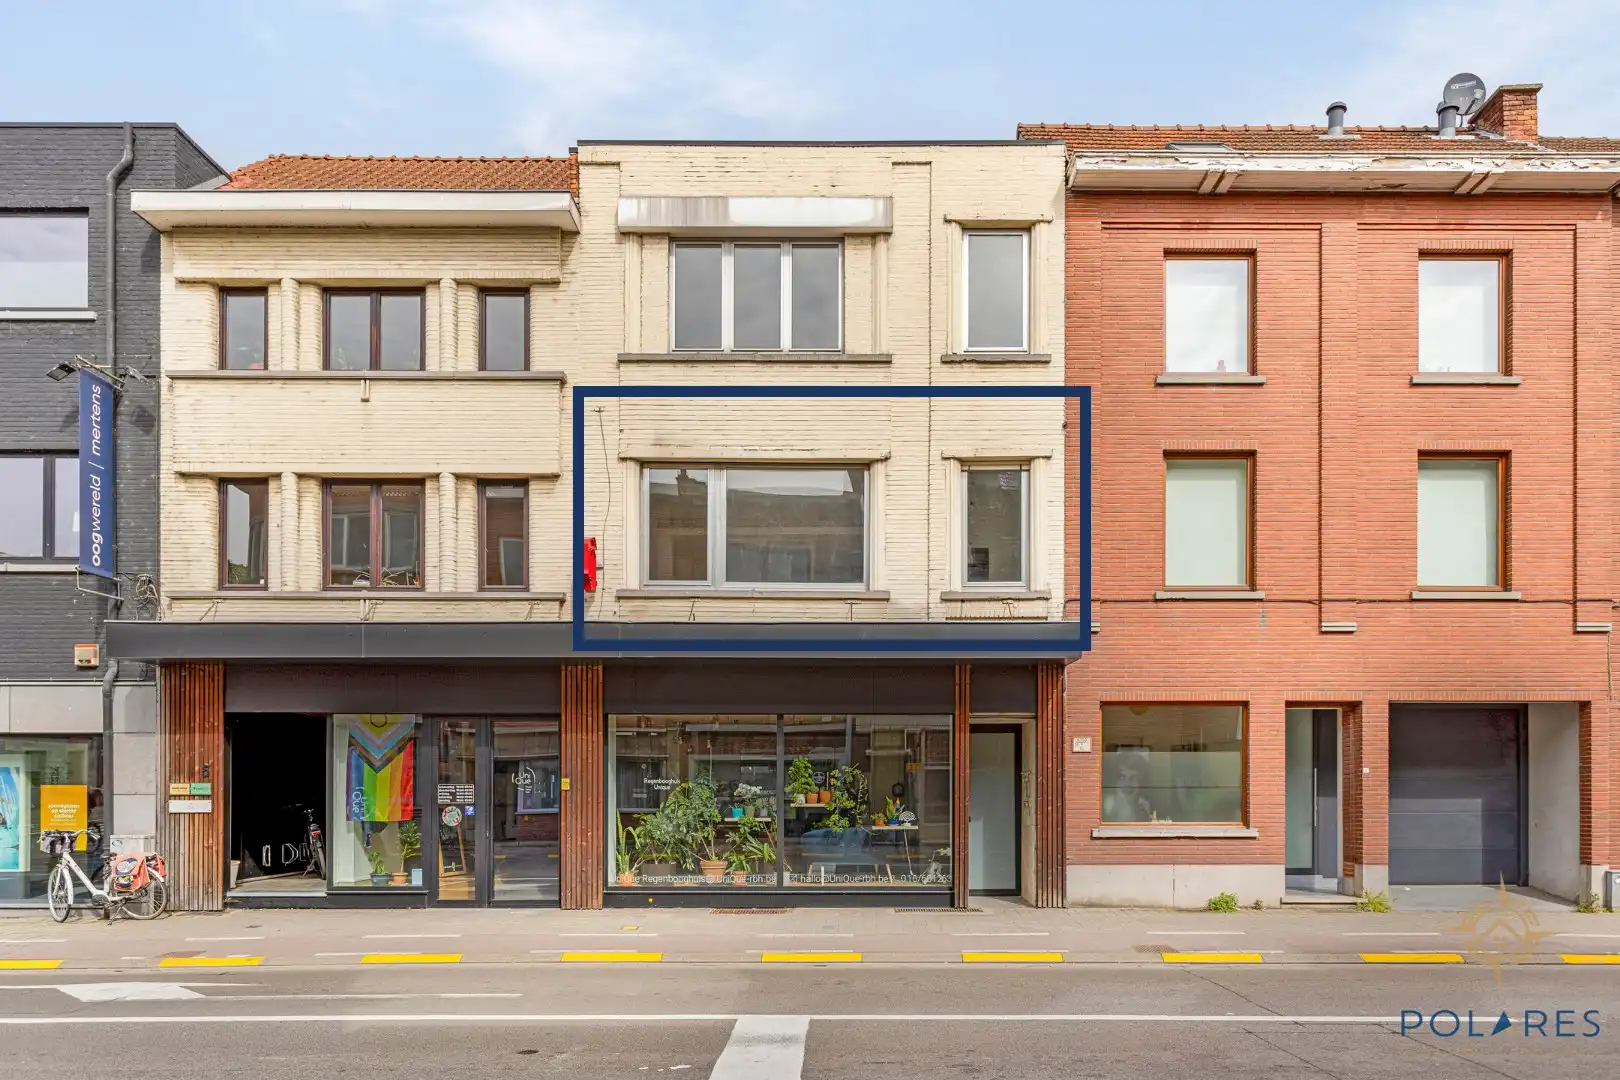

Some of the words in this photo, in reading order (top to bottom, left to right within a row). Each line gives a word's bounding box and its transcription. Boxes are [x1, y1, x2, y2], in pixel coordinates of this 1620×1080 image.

[91, 384, 101, 456] mertens
[90, 474, 103, 567] oogwereld
[642, 874, 705, 885] Regenbooghuis
[800, 874, 888, 883] hallo@UniQue-rbhbe
